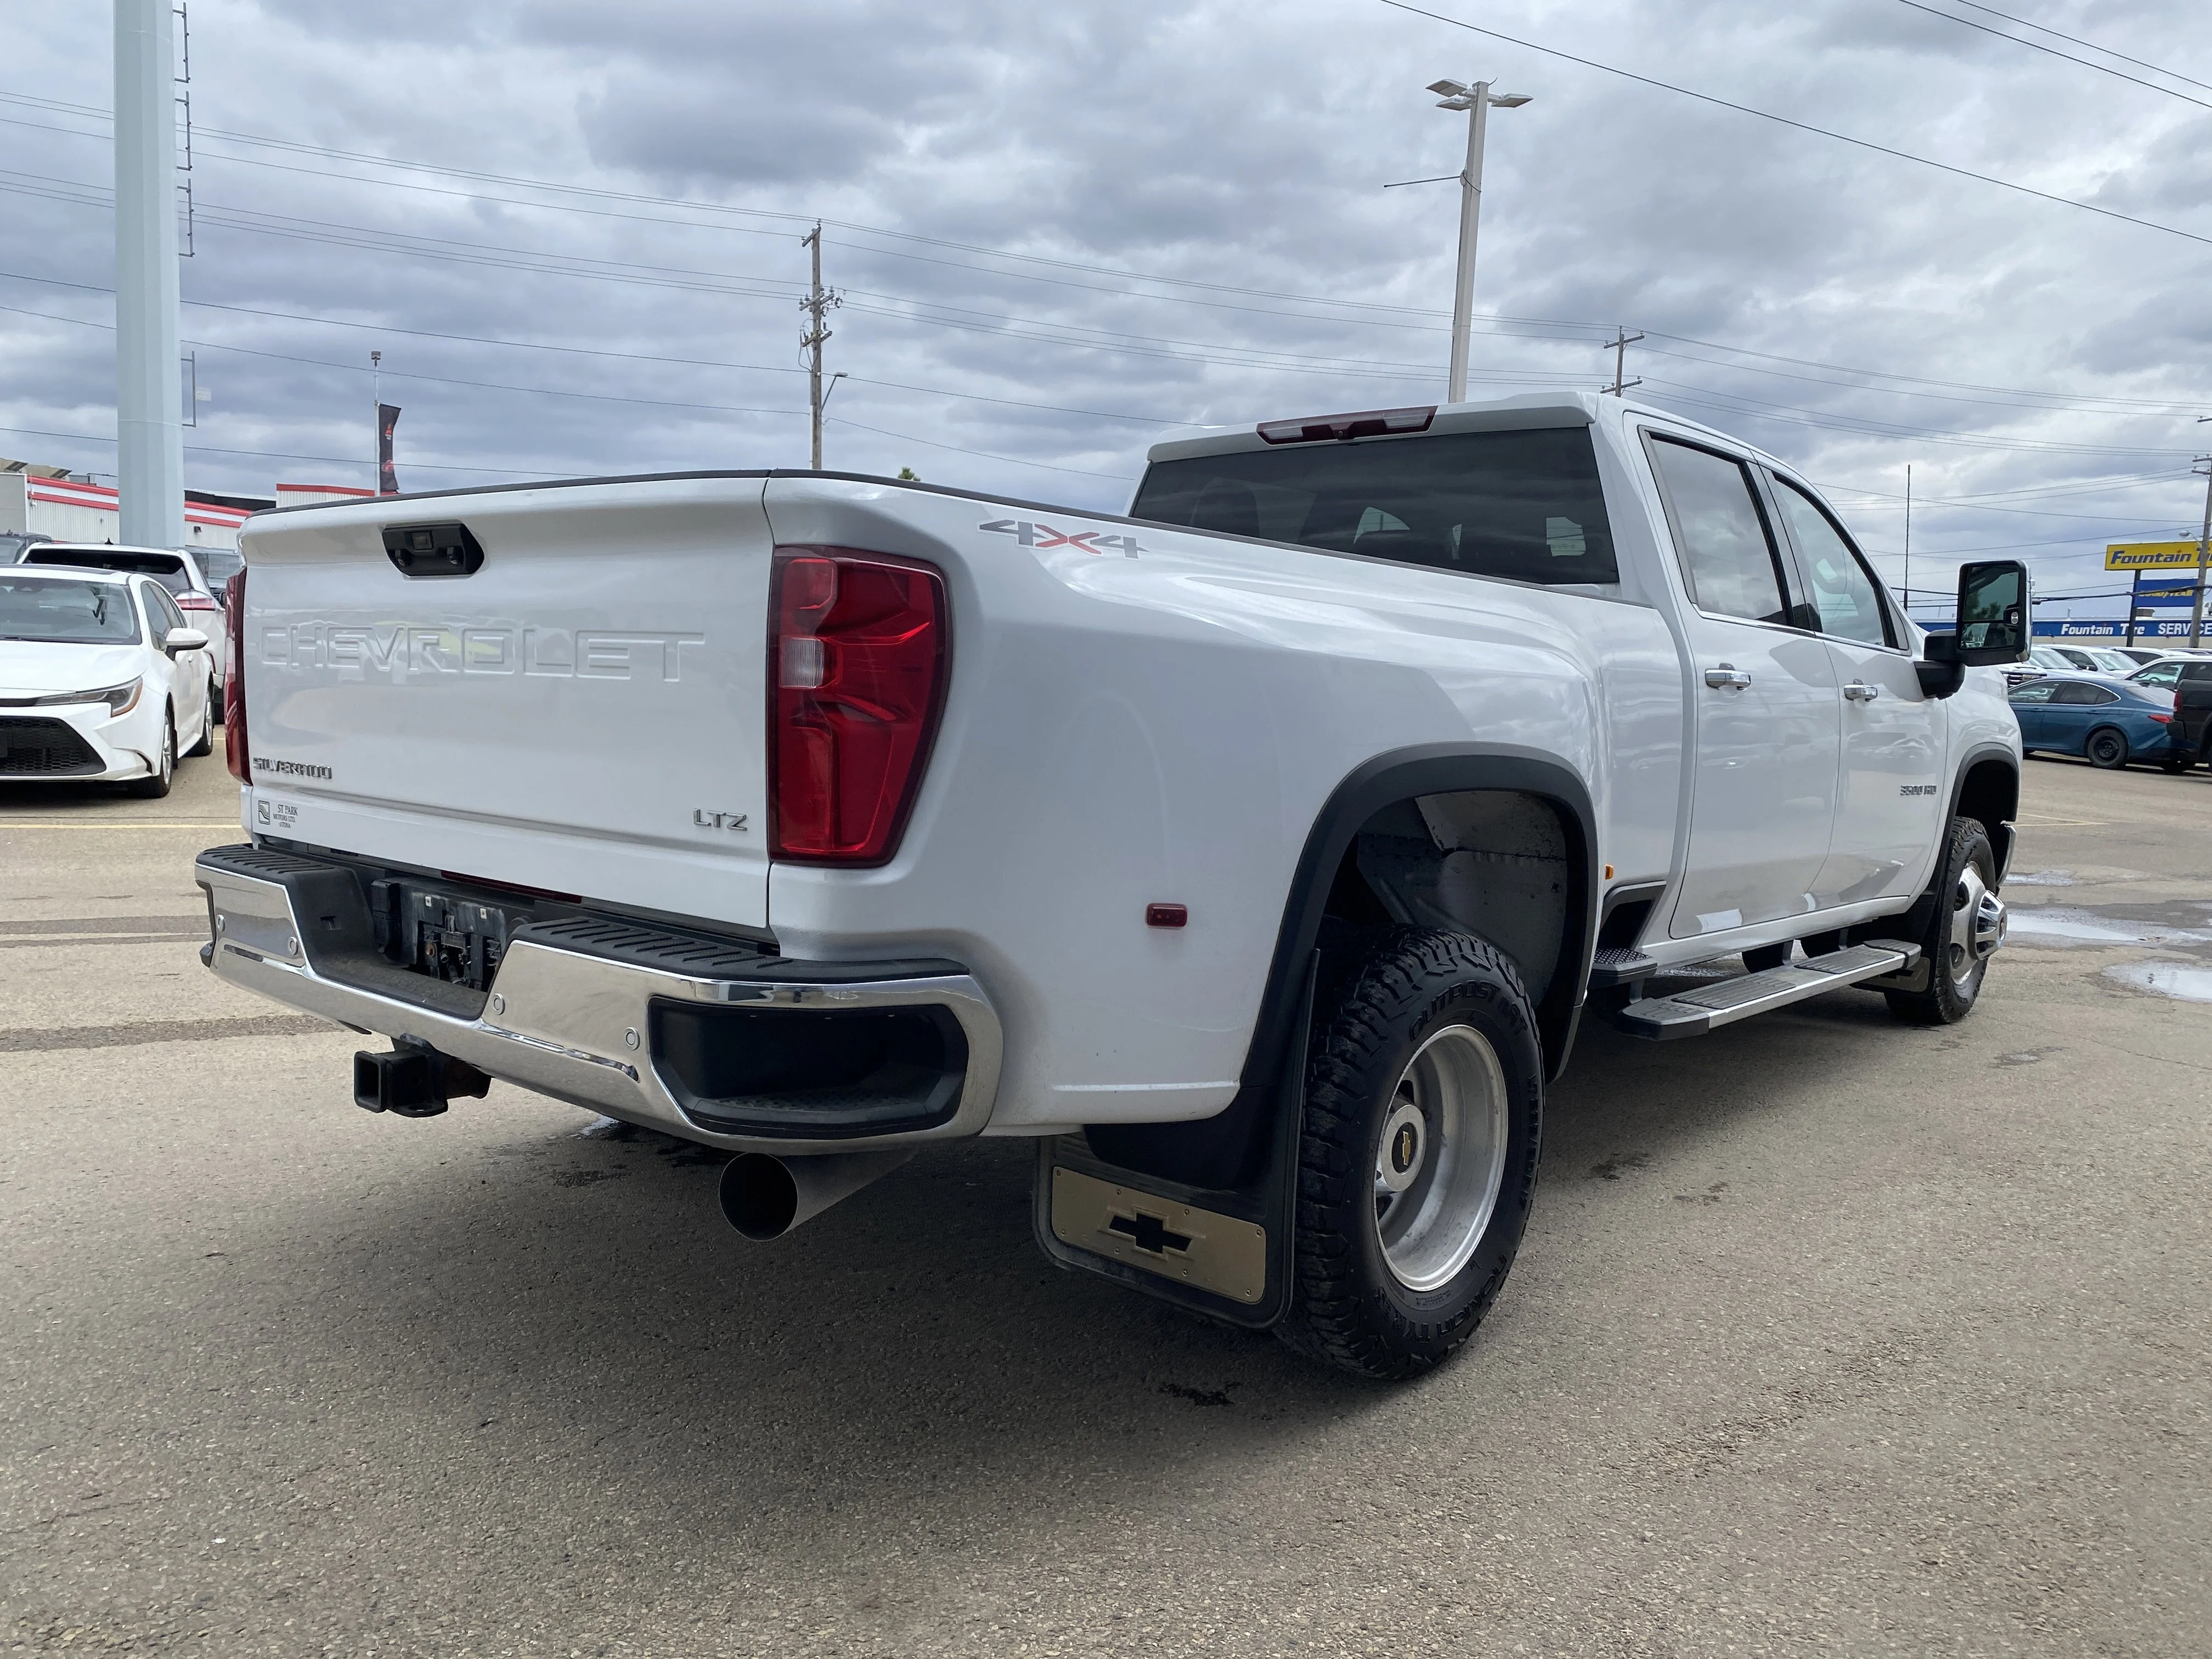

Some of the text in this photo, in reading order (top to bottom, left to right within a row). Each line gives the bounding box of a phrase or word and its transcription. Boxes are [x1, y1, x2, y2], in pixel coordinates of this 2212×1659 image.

[980, 520, 1149, 558] 4X4
[2111, 549, 2192, 565] Fountain
[2061, 623, 2212, 635] Fountain Tre SERVCE
[261, 625, 704, 682] CHEVROLET
[253, 757, 332, 779] SILVERADO
[273, 813, 287, 821] MOTORS
[278, 804, 298, 816] ST PARK
[693, 808, 747, 831] LTZ
[1409, 979, 1501, 1043] OUTPOST
